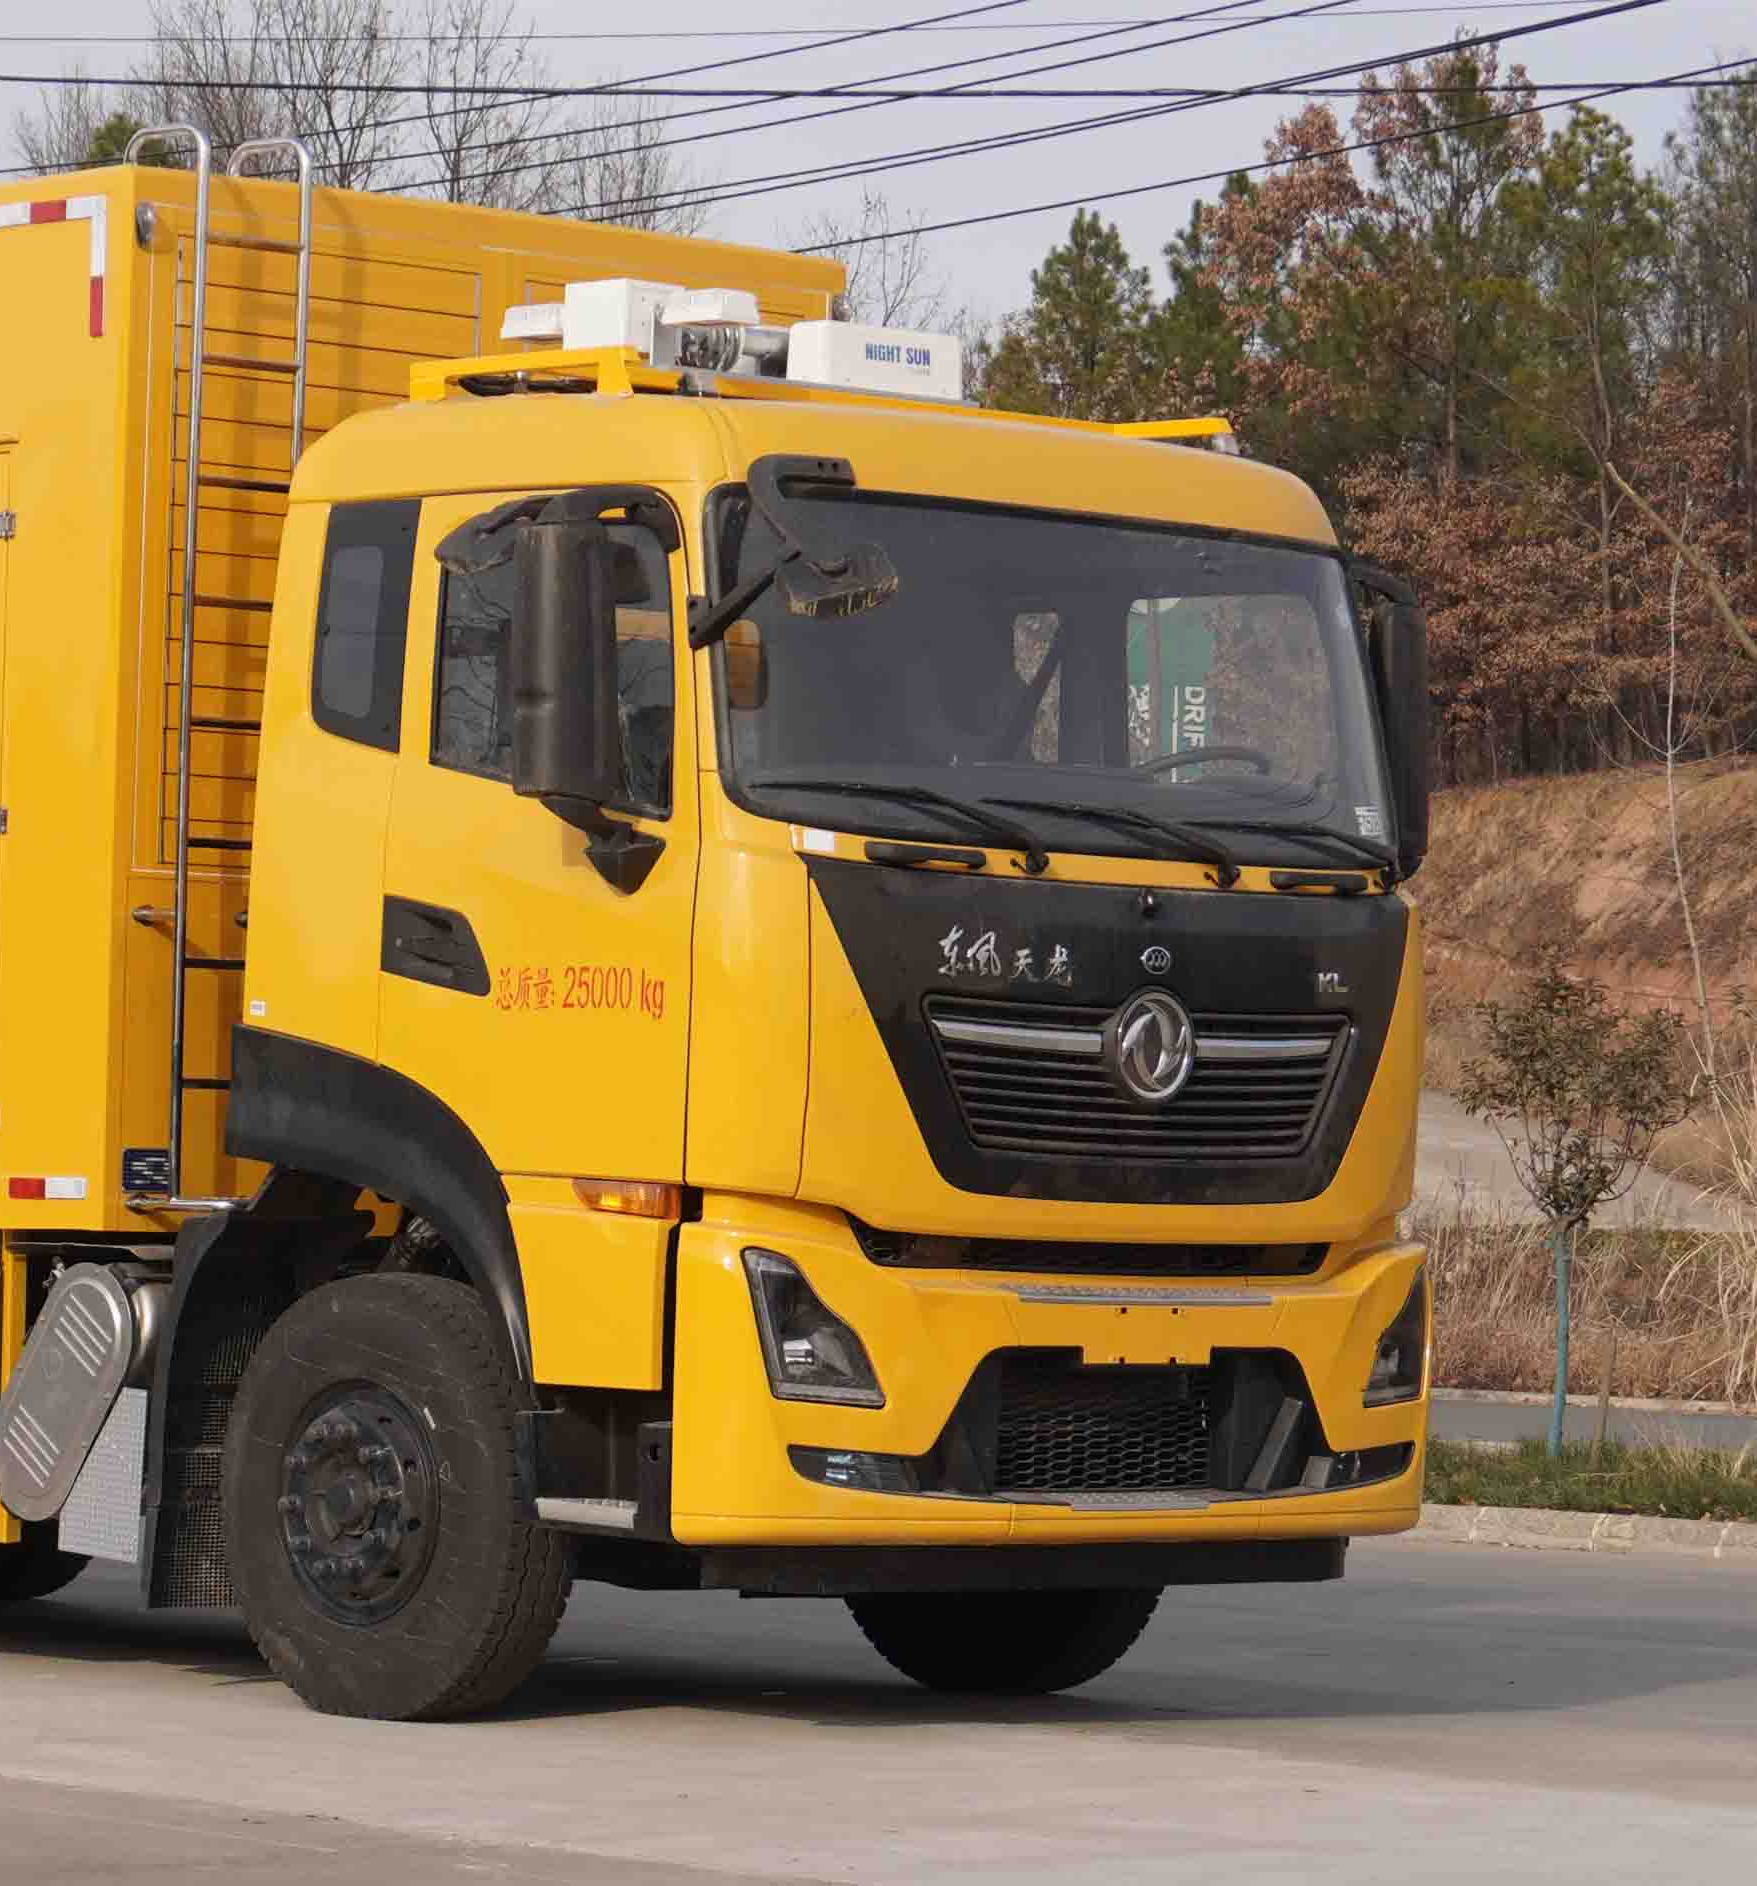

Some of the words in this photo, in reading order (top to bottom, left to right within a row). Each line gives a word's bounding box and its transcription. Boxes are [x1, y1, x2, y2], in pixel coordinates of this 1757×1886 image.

[865, 343, 901, 363] NIGHT
[906, 347, 930, 366] SUN
[561, 966, 633, 1009] 25000
[641, 967, 665, 1020] kg
